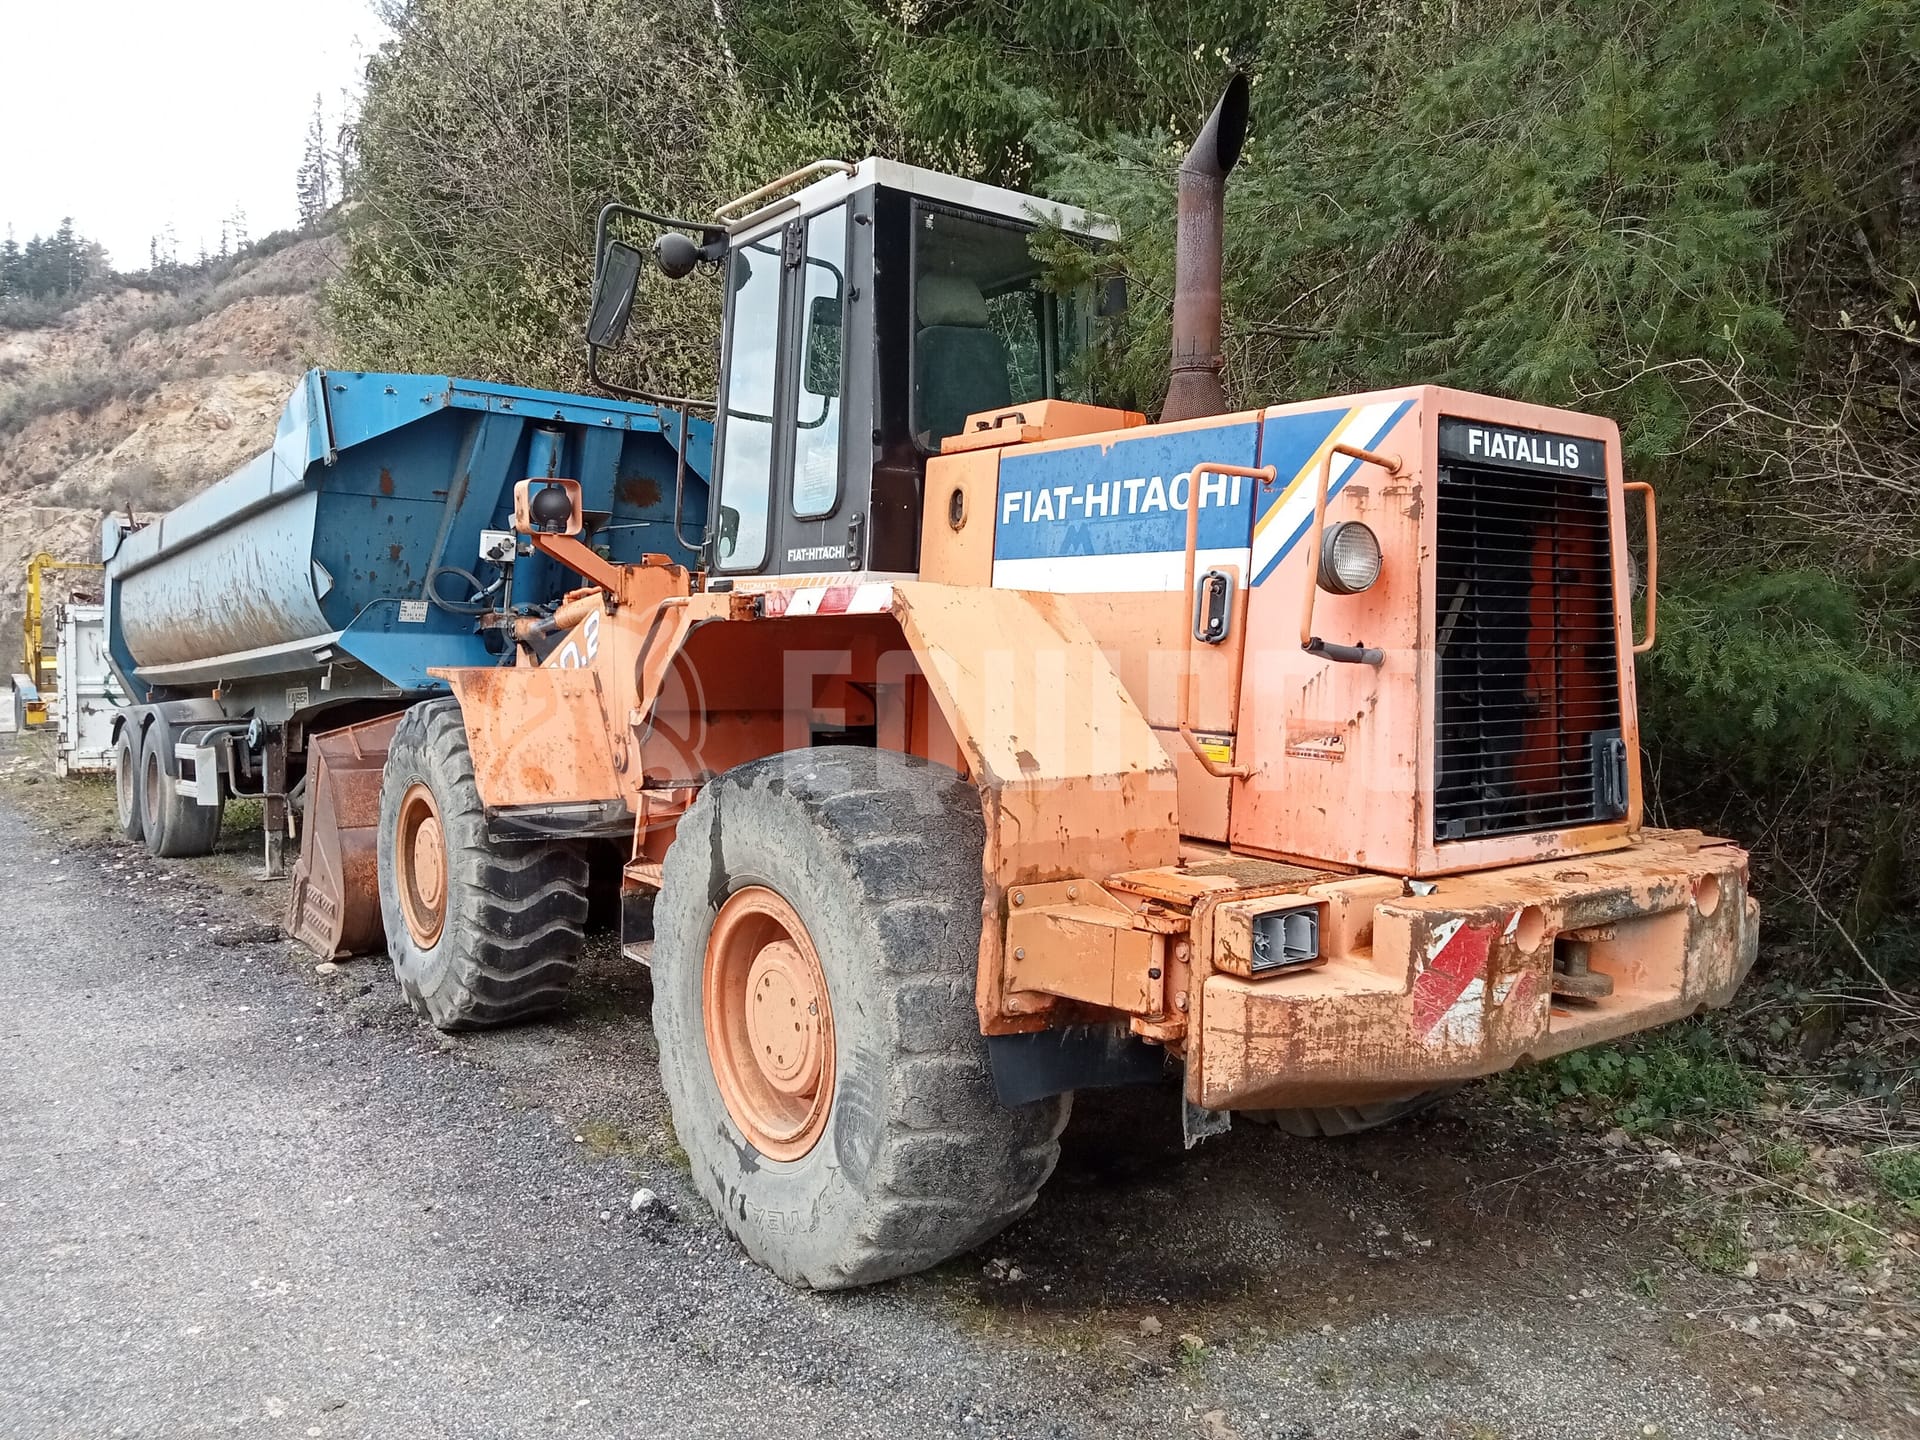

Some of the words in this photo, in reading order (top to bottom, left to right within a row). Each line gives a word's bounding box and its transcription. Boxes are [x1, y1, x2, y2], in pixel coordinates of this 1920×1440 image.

[1468, 428, 1579, 469] FIATALLIS
[1002, 472, 1241, 525] FIAT-HITACHI
[787, 545, 845, 562] FIAT-HITACHI
